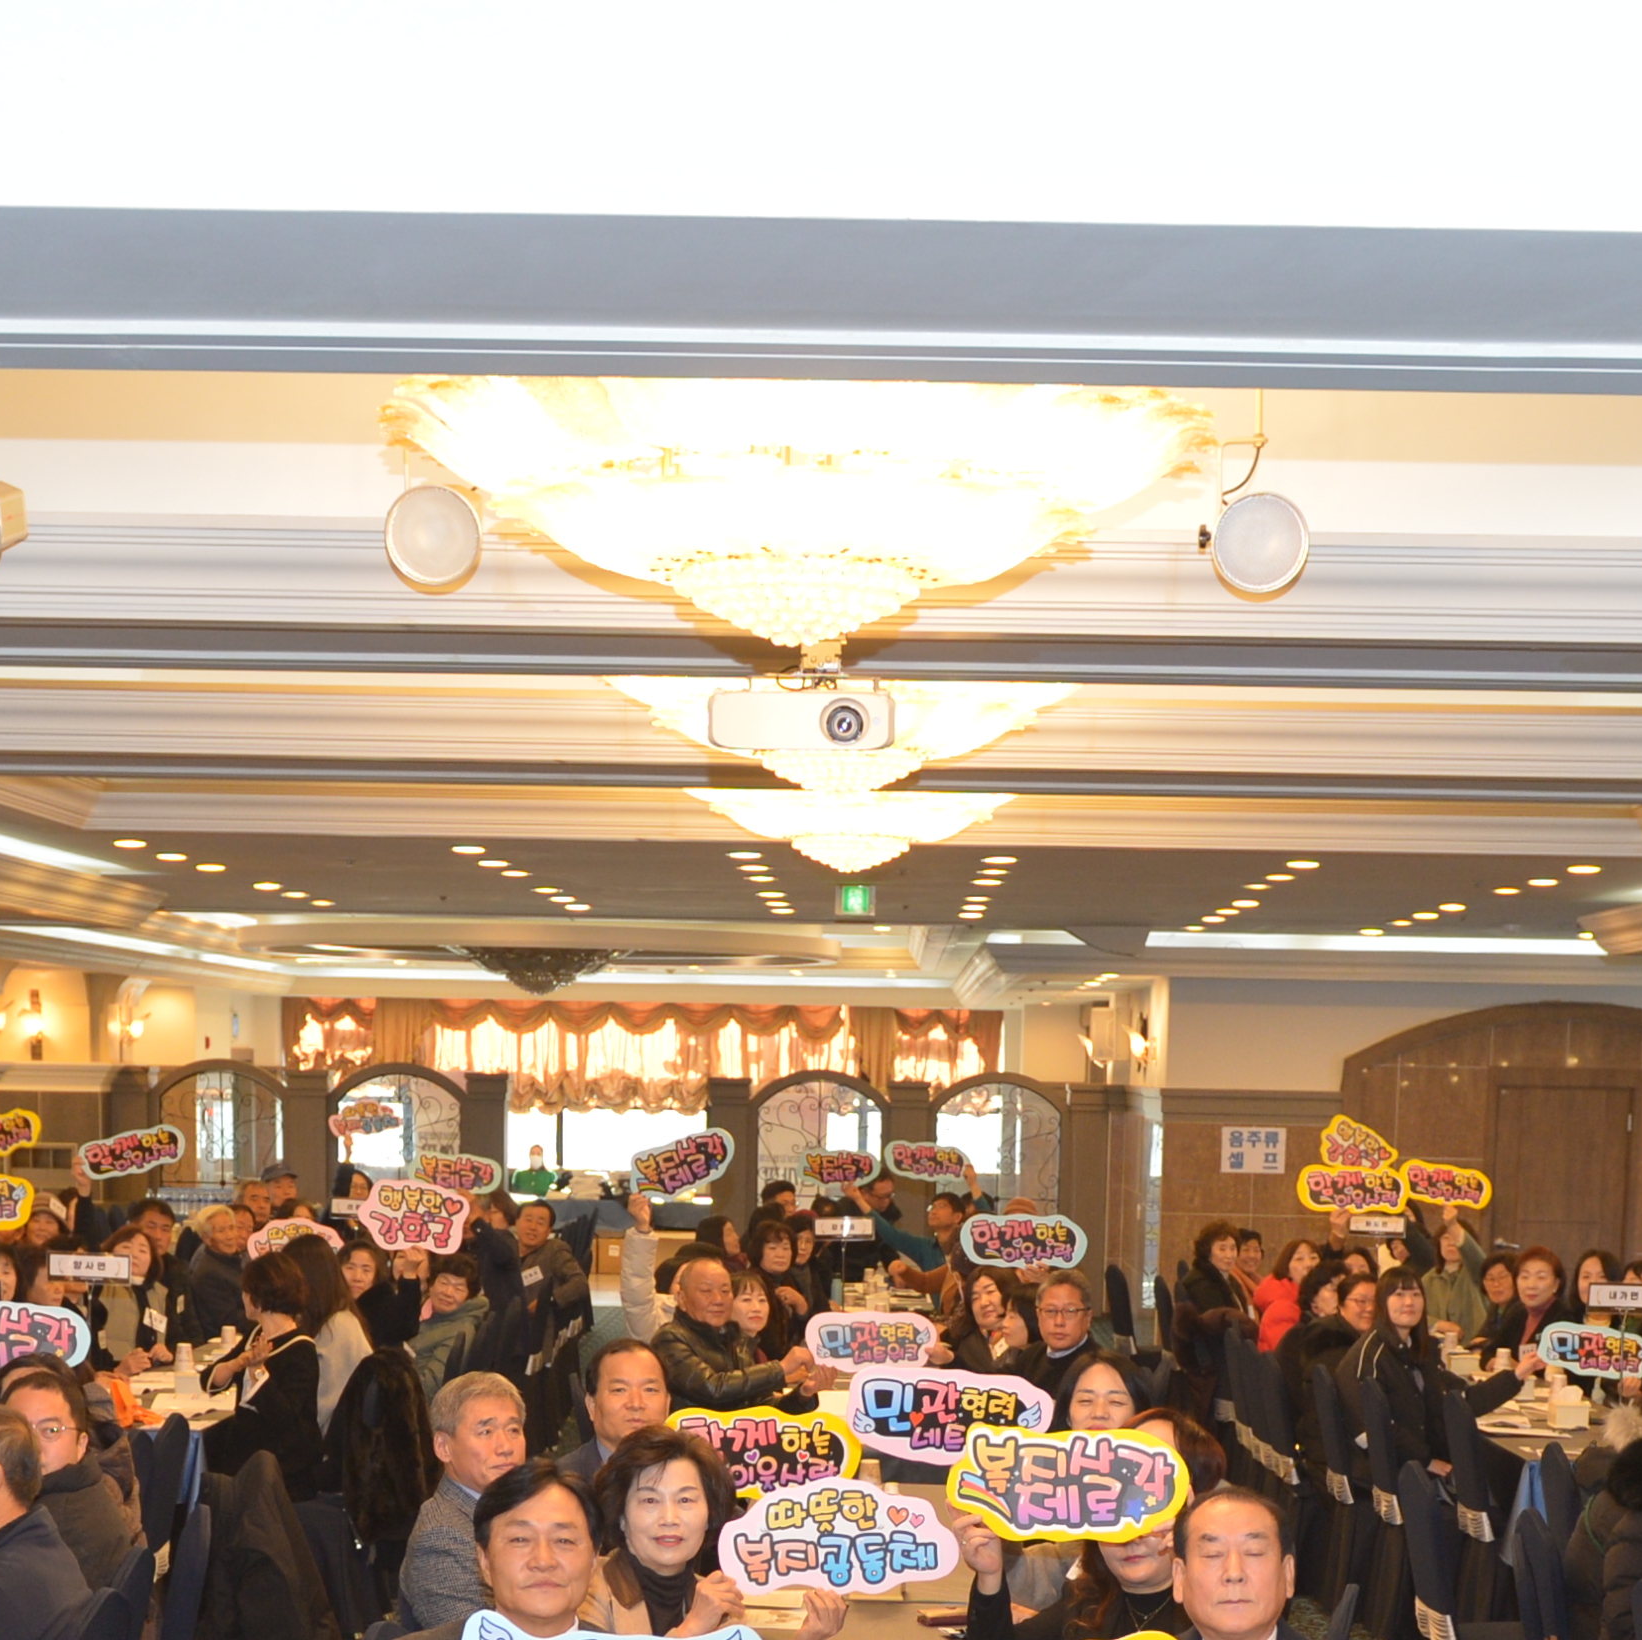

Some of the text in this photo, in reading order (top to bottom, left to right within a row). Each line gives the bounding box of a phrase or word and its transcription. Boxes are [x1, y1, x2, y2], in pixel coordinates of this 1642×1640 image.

[660, 1153, 709, 1194] 제로
[379, 1185, 444, 1214] 행복한
[370, 1210, 454, 1249] 강화군
[1000, 1240, 1074, 1265] 이웃사랑
[853, 1343, 918, 1364] 네트워크
[909, 1422, 967, 1451] 네트
[973, 1434, 1175, 1501] 복지사각
[766, 1488, 878, 1533] 따뜻한
[1011, 1472, 1124, 1529] 제로
[734, 1530, 937, 1587] 복지공동체
